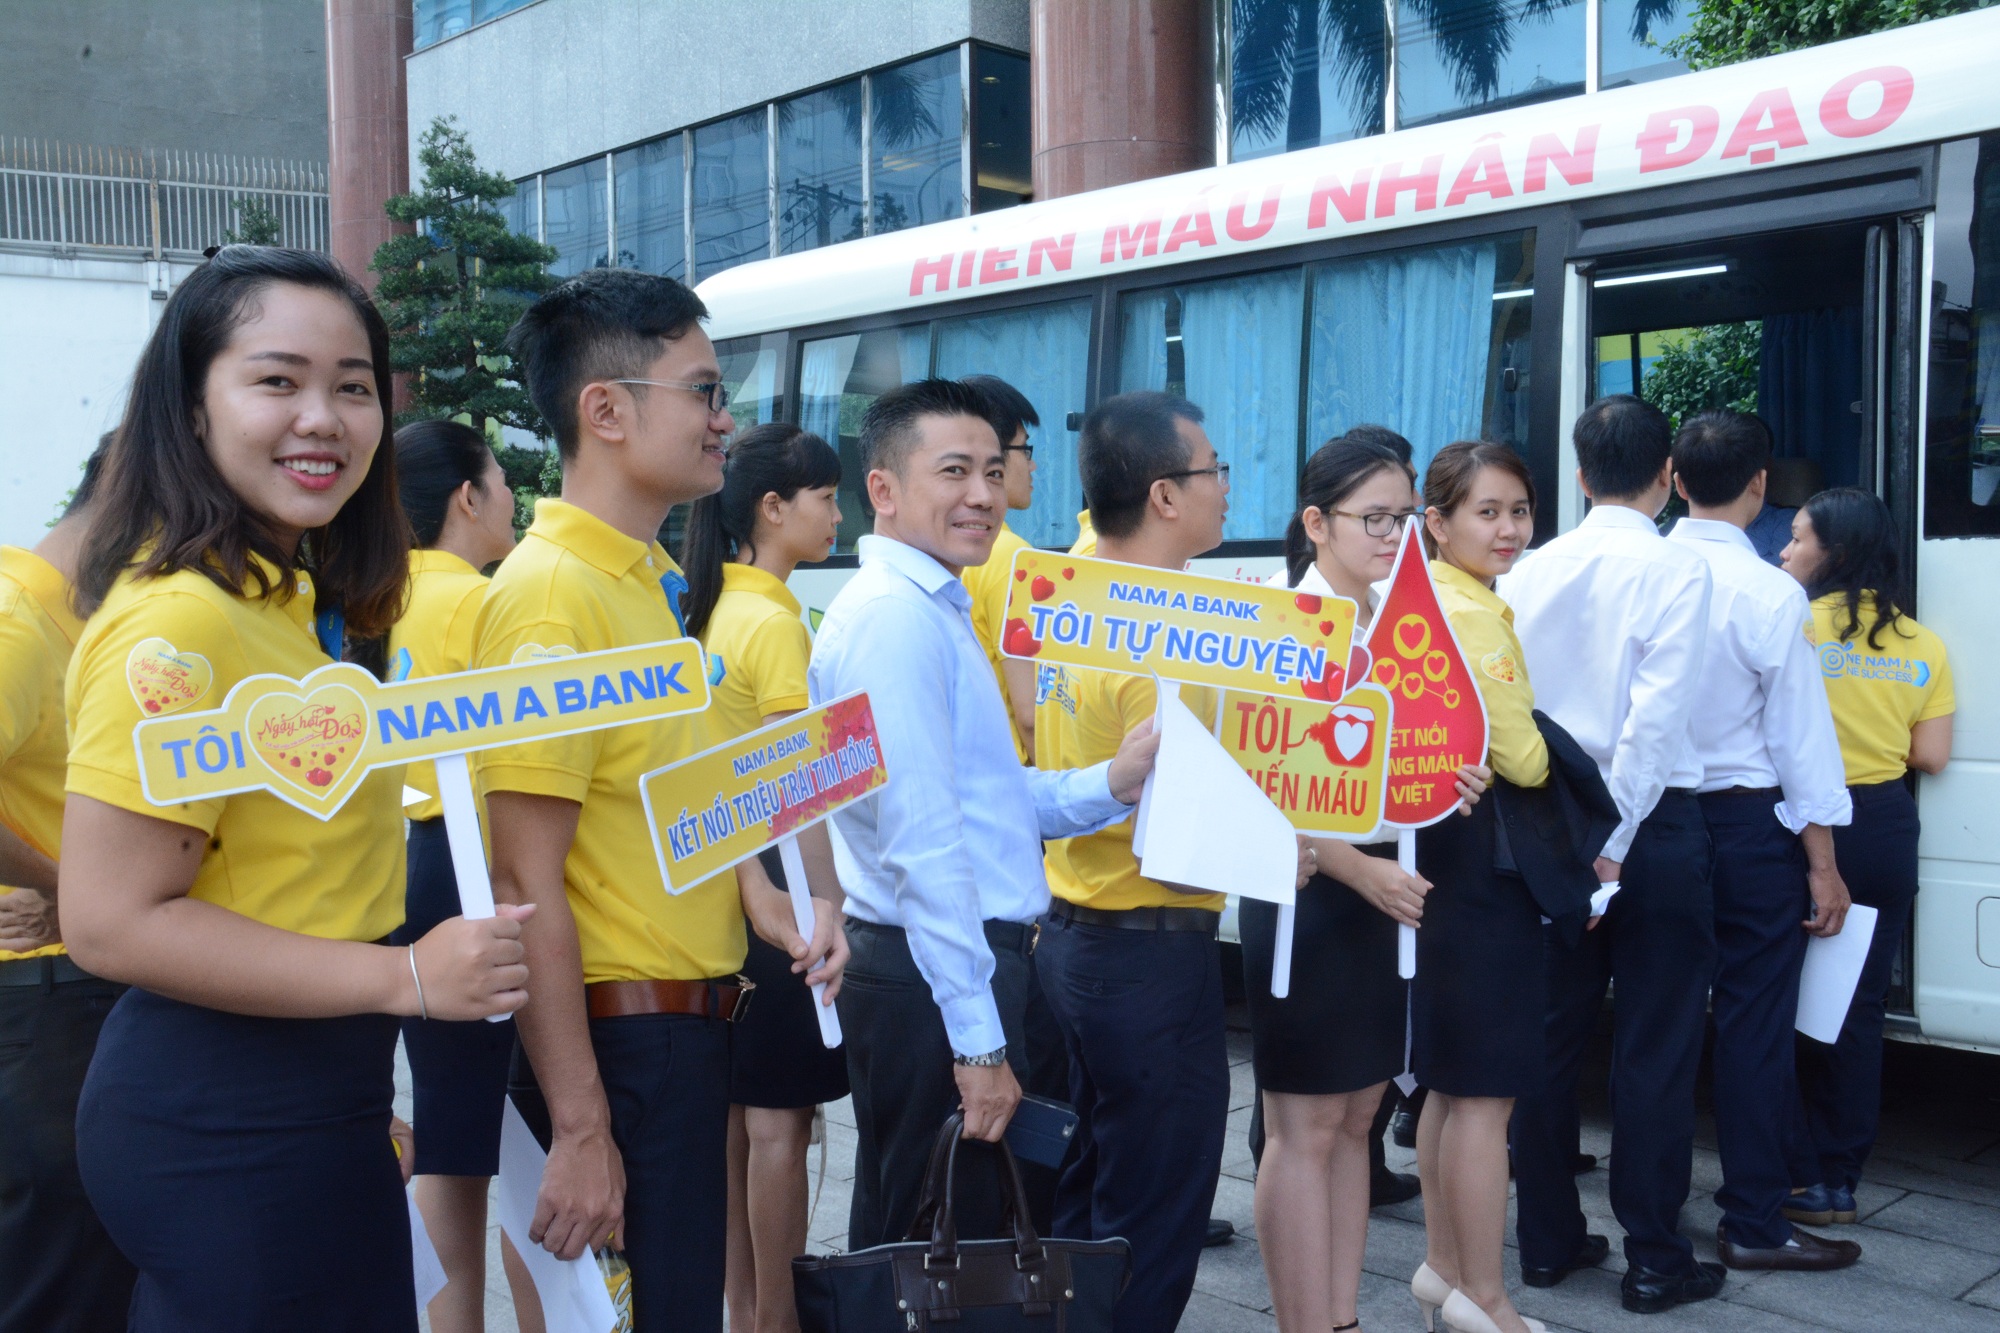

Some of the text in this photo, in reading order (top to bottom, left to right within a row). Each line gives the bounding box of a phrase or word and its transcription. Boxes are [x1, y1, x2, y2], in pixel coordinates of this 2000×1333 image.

[1307, 124, 1600, 229] NHÂN
[1635, 65, 1914, 175] ĐẠO
[1109, 582, 1263, 621] NAM A BANK
[1030, 602, 1327, 683] TÔI TỰ NGUYỆN
[1865, 656, 1900, 668] NAM
[1904, 660, 1912, 670] A
[1862, 668, 1912, 683] SUCCESS
[161, 661, 691, 779] TÔI NAM A BANK
[1236, 695, 1292, 755] TÔI
[1390, 720, 1448, 748] ẾT NỐI
[733, 730, 811, 777] NAM A BANK
[1418, 751, 1463, 775] MÁU
[668, 735, 878, 861] KẾT NỐI TRIỆU TRÁI TIM HỒNG
[1306, 770, 1368, 817] MÁU
[1390, 781, 1435, 806] VIỆT
